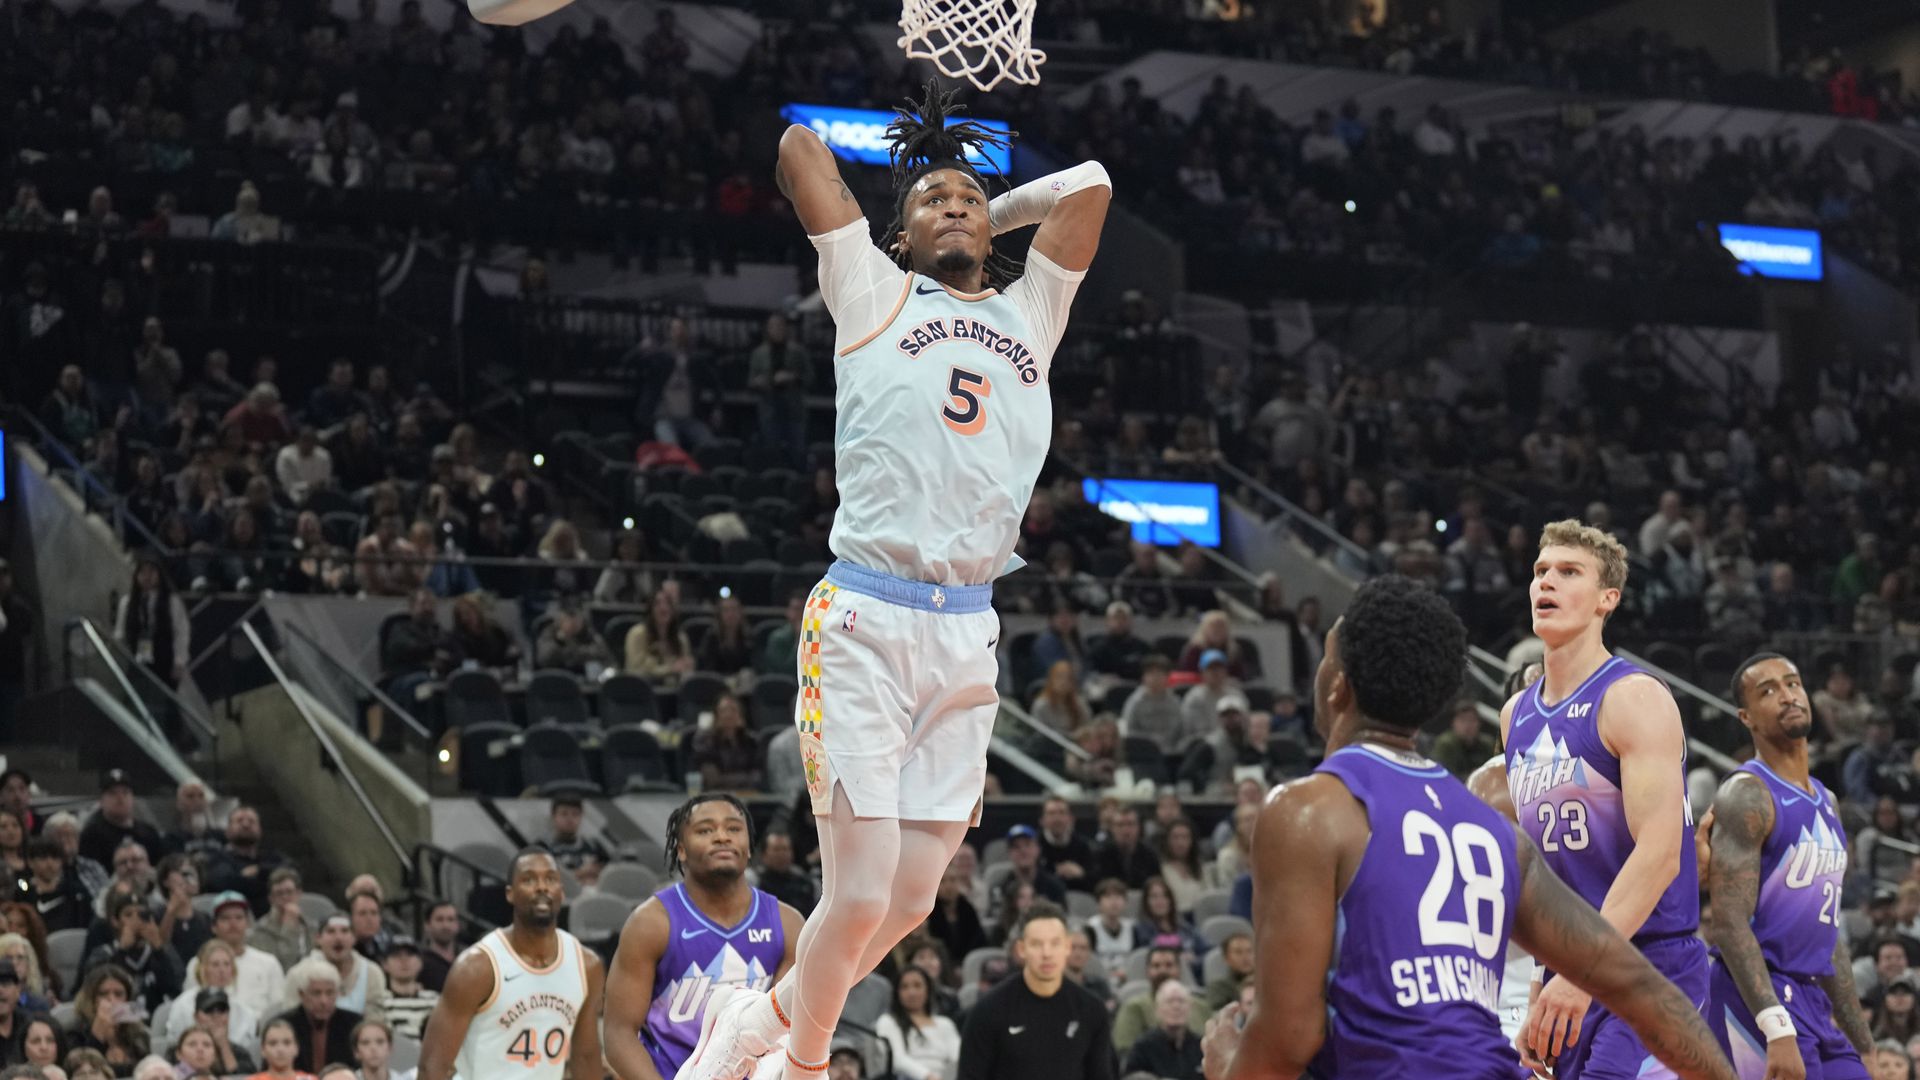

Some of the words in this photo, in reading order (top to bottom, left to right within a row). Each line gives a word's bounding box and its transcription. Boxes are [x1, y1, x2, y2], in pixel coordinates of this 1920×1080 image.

[897, 317, 949, 360] SAN
[951, 316, 1040, 388] ANTONIO
[941, 365, 990, 434] 5
[1567, 702, 1592, 719] LVT
[1508, 756, 1579, 822] UTAH
[1536, 799, 1591, 853] 23
[1402, 809, 1505, 960] 28
[1785, 840, 1848, 889] UTAH
[747, 928, 773, 943] LVT
[499, 1000, 528, 1029] SAN
[505, 1027, 569, 1066] 40
